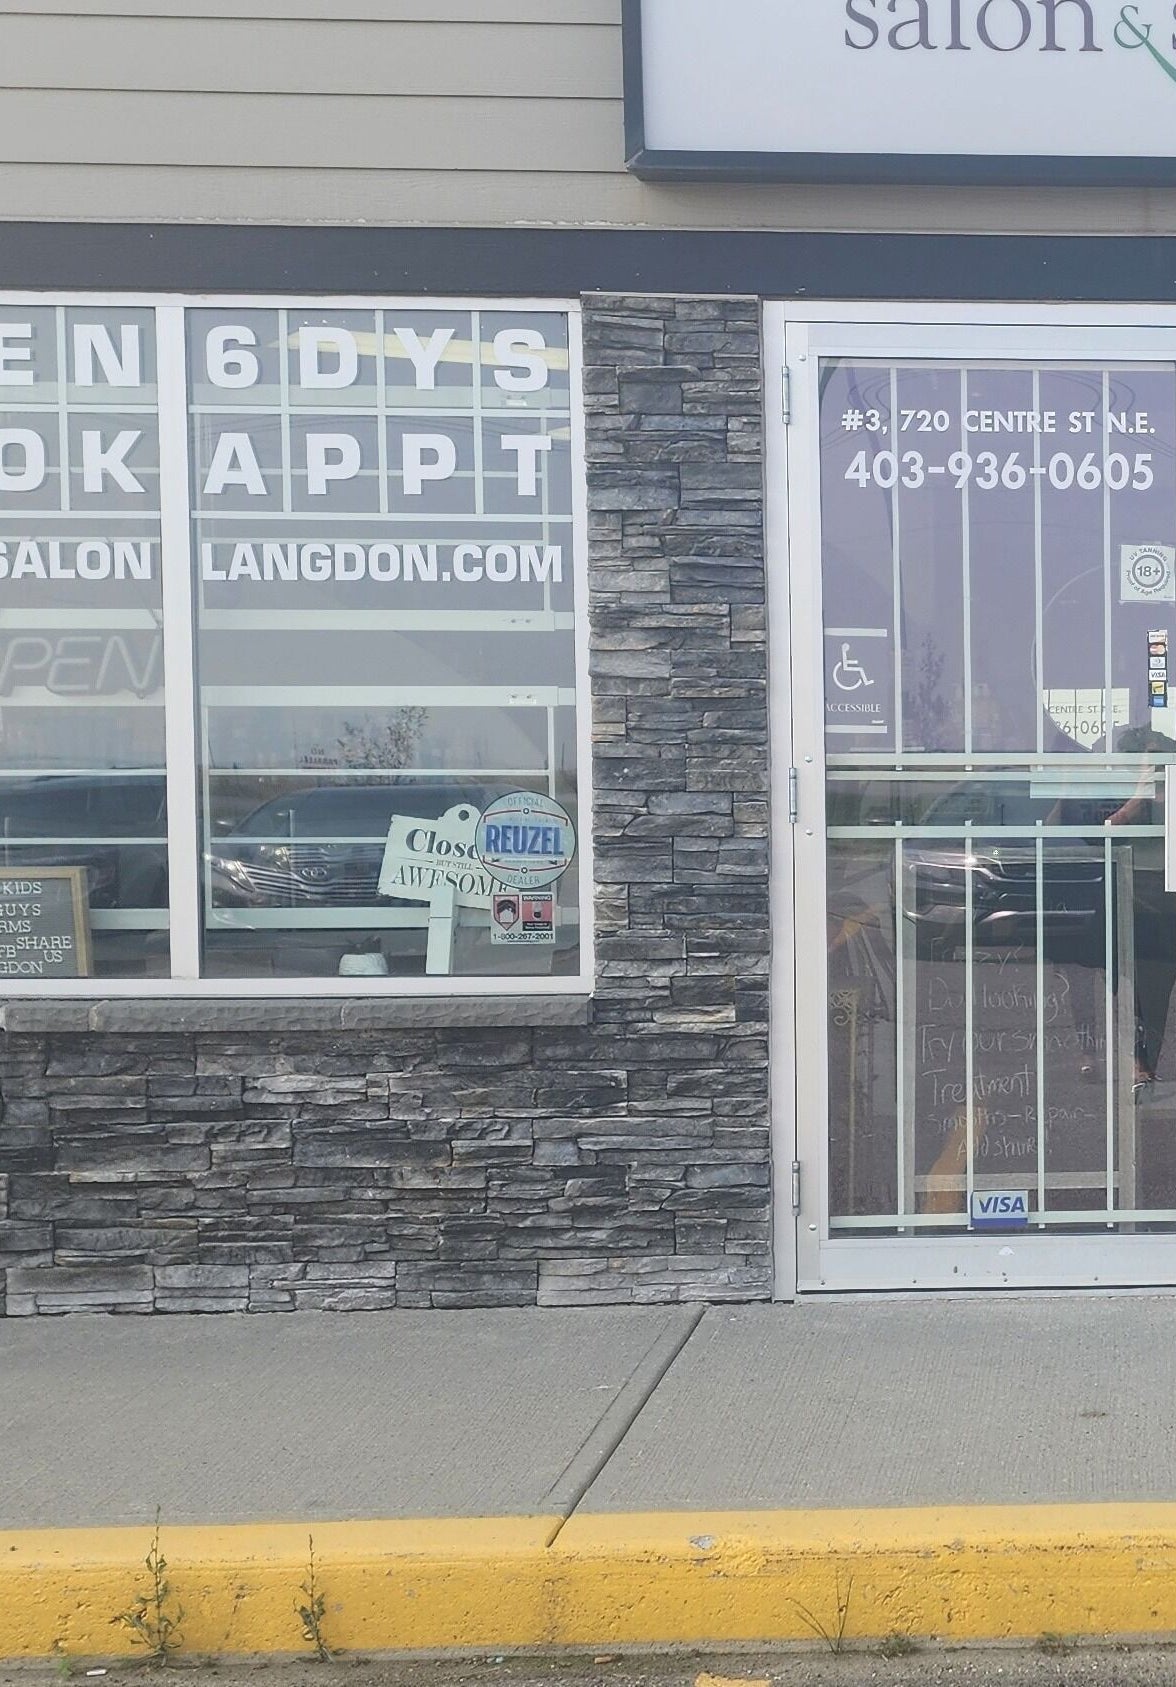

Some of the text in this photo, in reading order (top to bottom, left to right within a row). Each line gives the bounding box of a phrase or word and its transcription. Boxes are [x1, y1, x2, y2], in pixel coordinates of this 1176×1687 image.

[841, 409, 1155, 435] #3, 720 CENTRE ST N.E.
[202, 432, 552, 496] APPT
[844, 450, 1154, 490] 403-936-0605
[0, 540, 563, 582] ALON LANGDON.COM
[1139, 547, 1168, 562] TANNING
[1137, 565, 1161, 577] 18+
[405, 828, 479, 860] Clos
[485, 825, 564, 855] REUZEL
[507, 874, 540, 885] DEALER
[2, 881, 42, 895] KIDS
[0, 903, 41, 916] UYS
[16, 935, 72, 950] SHARE
[43, 949, 63, 963] US
[979, 1196, 1025, 1214] VISA
